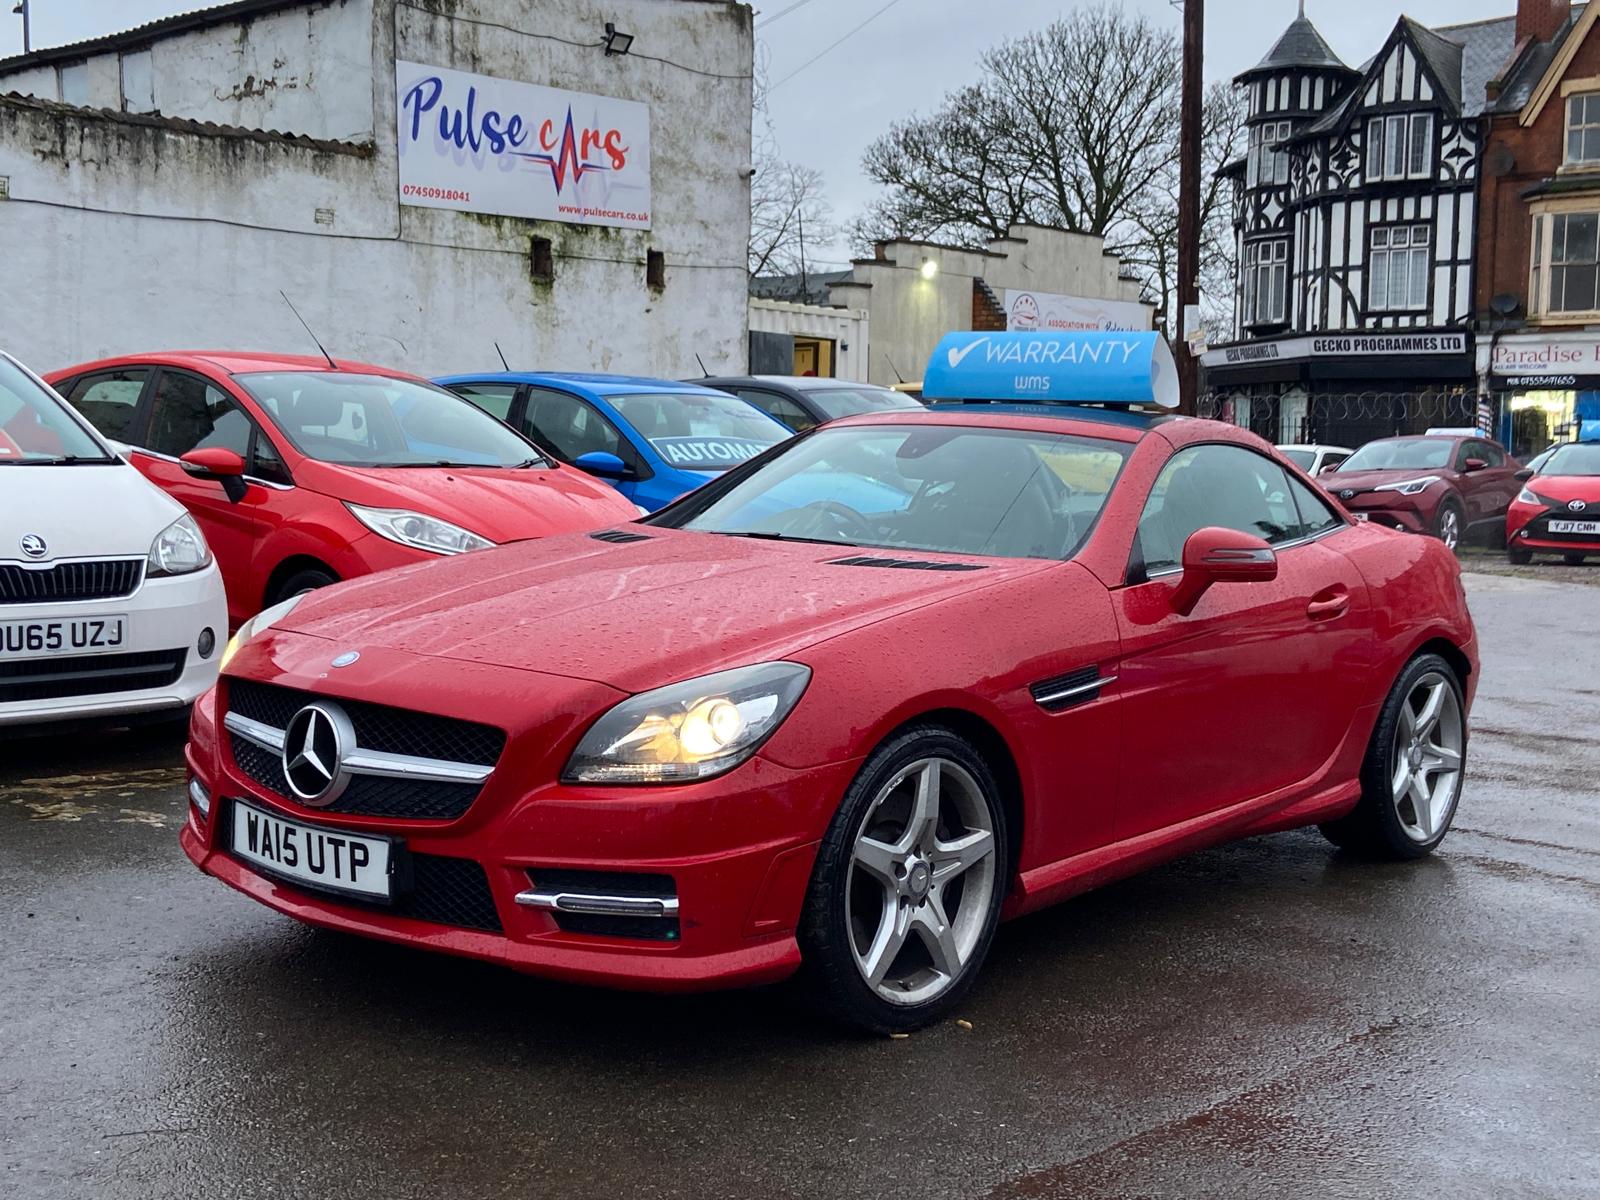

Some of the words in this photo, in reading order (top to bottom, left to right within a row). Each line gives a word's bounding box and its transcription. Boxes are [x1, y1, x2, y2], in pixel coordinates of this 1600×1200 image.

[403, 76, 528, 154] Pulse
[539, 104, 629, 196] cars
[403, 184, 471, 202] 07450918041
[558, 203, 649, 222] www.pulsecars.co.uk
[1048, 319, 1084, 330] ASSOCIATION
[986, 340, 1141, 364] WARRANTY
[1226, 350, 1240, 362] GECKO
[1239, 345, 1271, 360] PROGRAMMES
[1270, 343, 1279, 357] LTD
[1313, 339, 1351, 353] GECKO
[1353, 338, 1438, 352] PROGRAMMES
[1440, 337, 1461, 350] LTD
[1493, 345, 1582, 363] Paradise
[1014, 375, 1050, 390] wms
[0, 624, 62, 652] U65
[71, 620, 122, 648] UZJ
[247, 811, 298, 867] WA15
[306, 832, 370, 882] UTP
